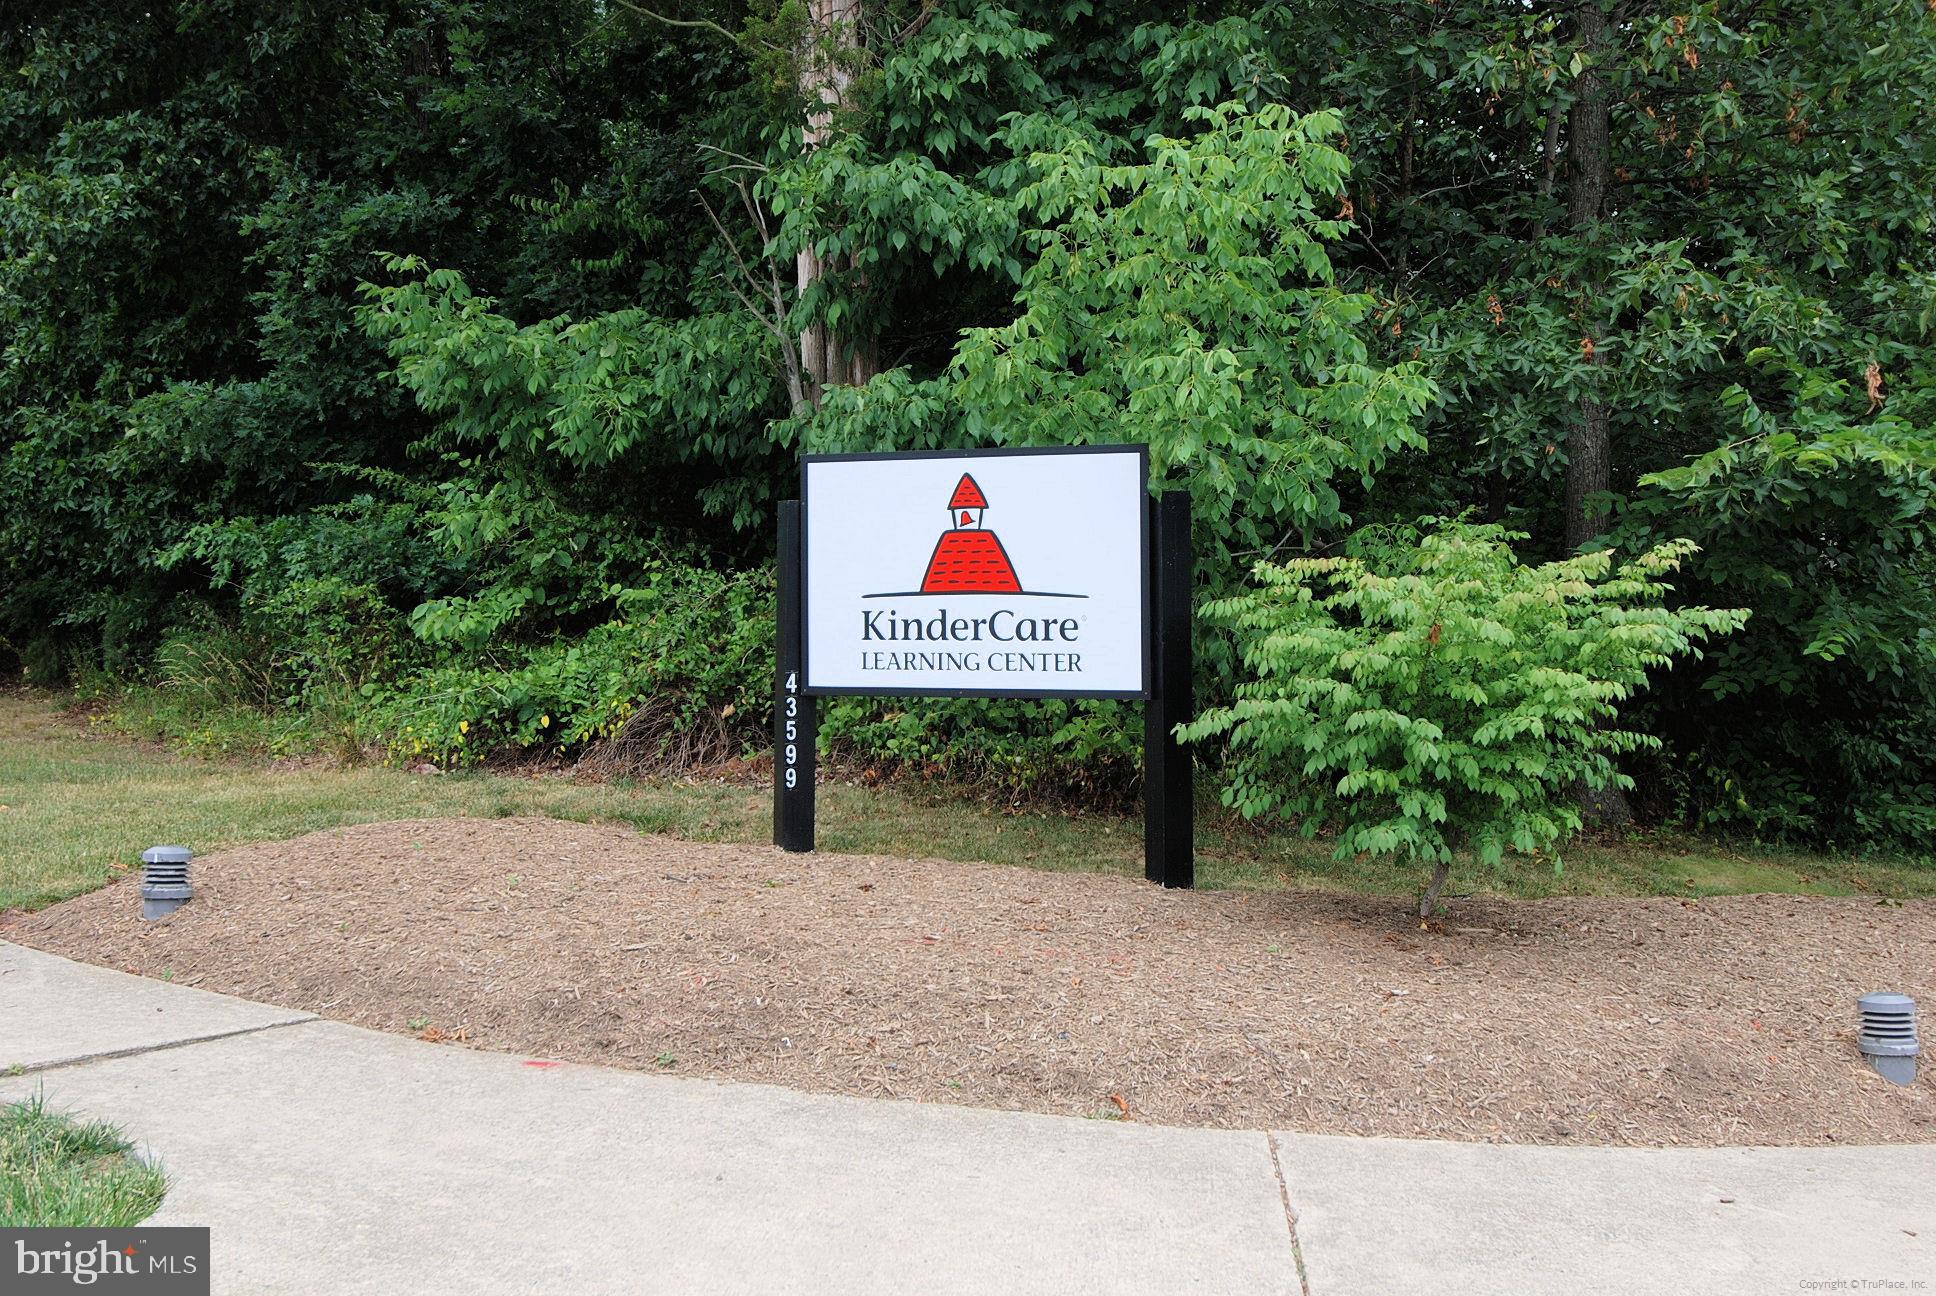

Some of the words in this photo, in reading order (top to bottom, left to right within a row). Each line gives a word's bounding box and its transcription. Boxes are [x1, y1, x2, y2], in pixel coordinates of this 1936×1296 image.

[862, 609, 1079, 642] KinderCare
[862, 652, 980, 671] LEARNING
[988, 652, 1082, 672] CENTER
[785, 673, 797, 788] 43599
